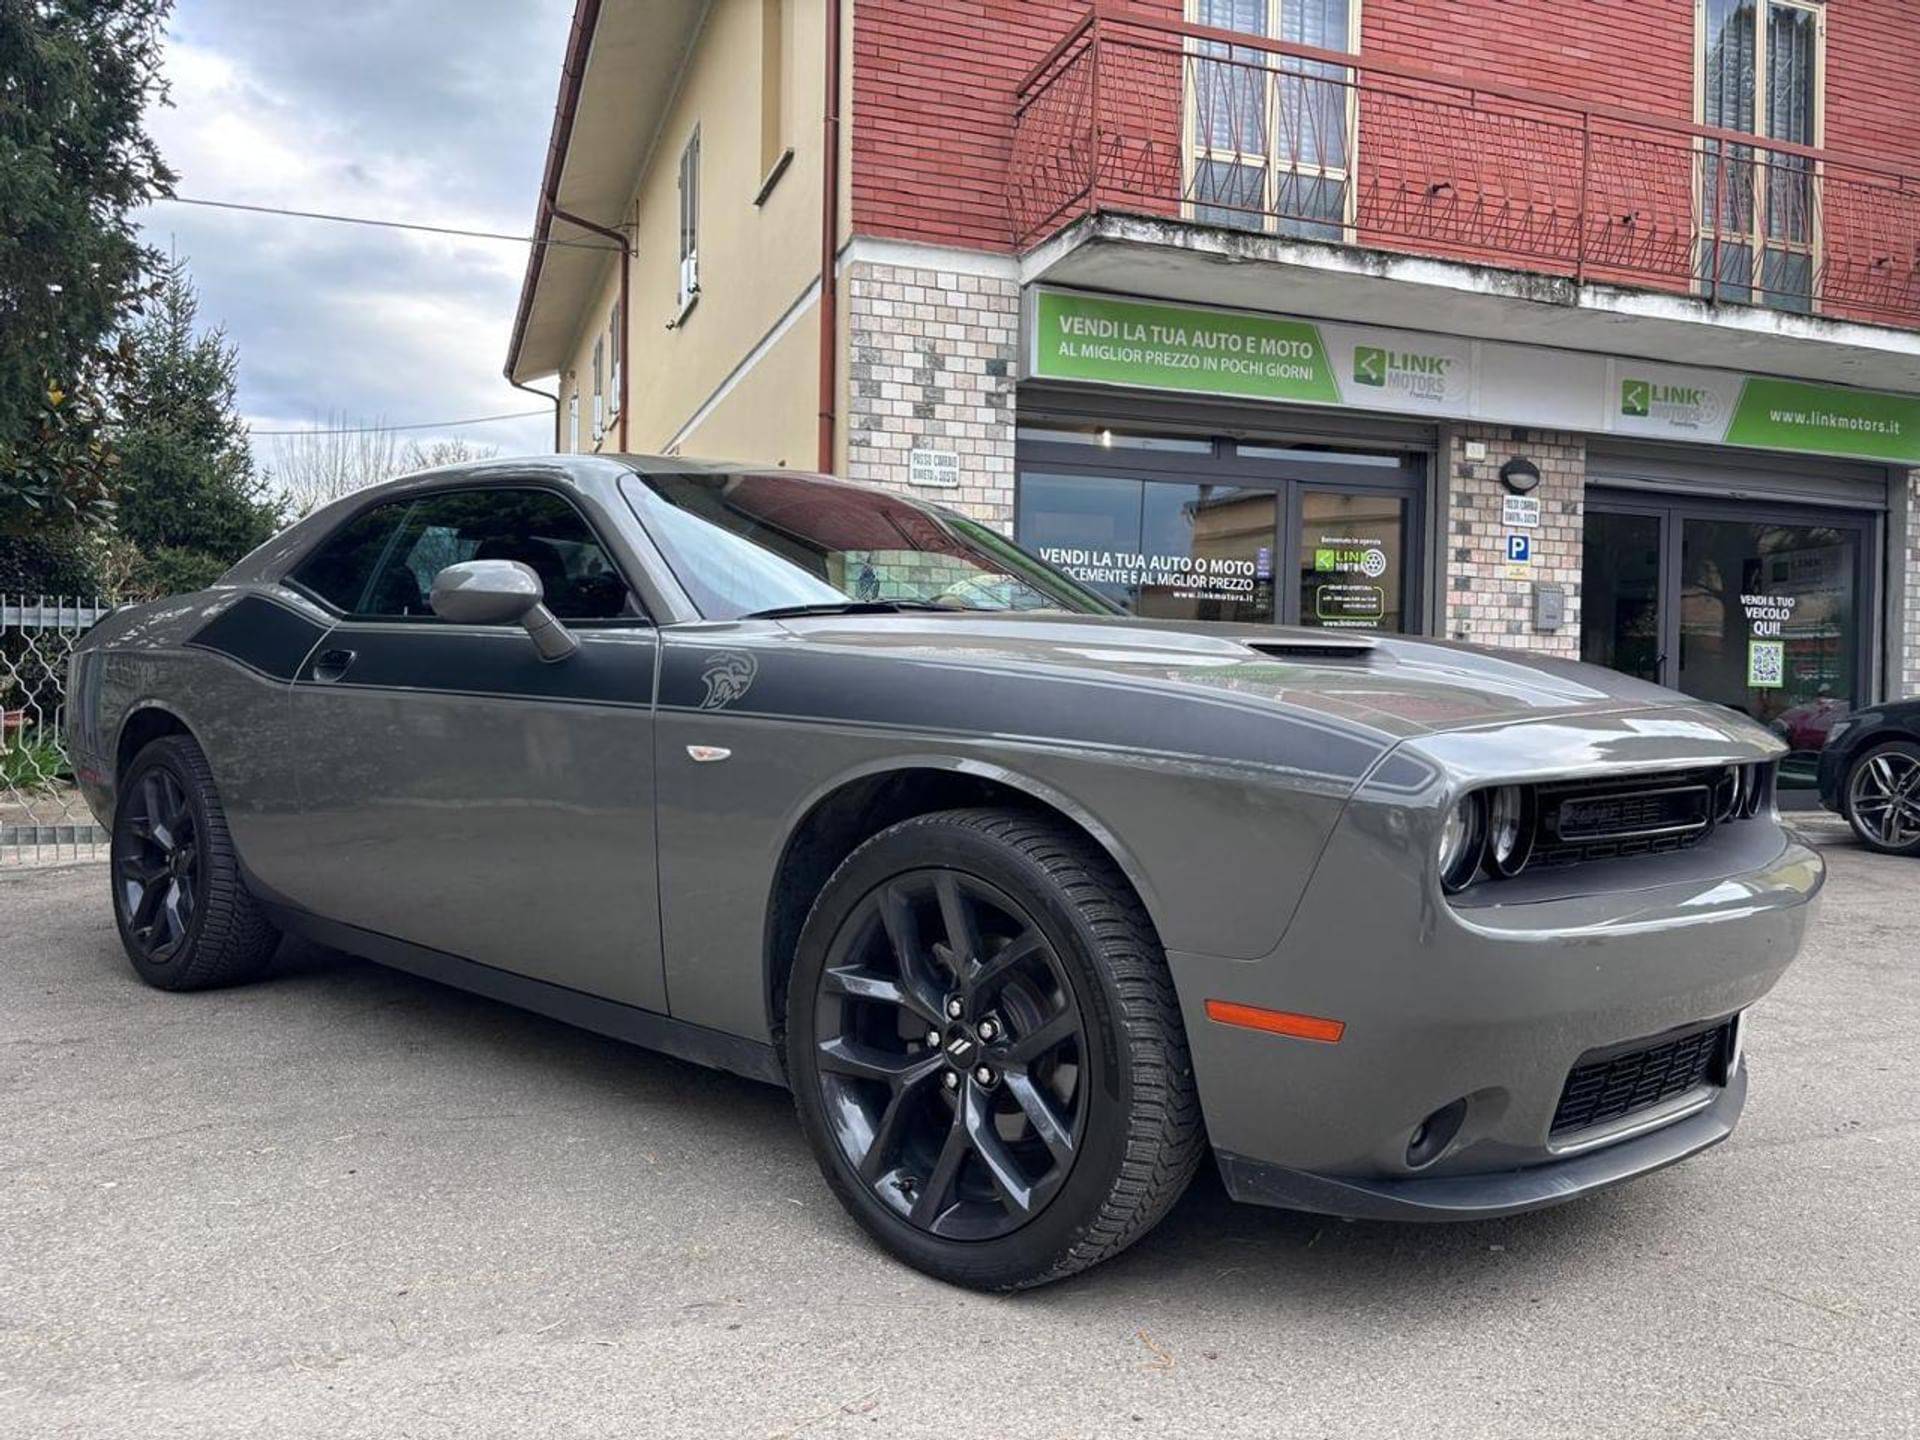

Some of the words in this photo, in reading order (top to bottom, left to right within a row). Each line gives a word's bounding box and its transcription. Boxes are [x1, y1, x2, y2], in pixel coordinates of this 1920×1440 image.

[1059, 315, 1119, 339] VENDI
[1123, 322, 1147, 342] LA
[1150, 325, 1188, 346] TUA
[1191, 330, 1242, 352] AUTO
[1246, 336, 1257, 354] E
[1260, 338, 1313, 359] MOTO
[1058, 341, 1078, 357] AL
[1080, 344, 1142, 363] MIGLIOR
[1144, 350, 1201, 369] PREZZO
[1203, 357, 1218, 371] IN
[1220, 358, 1263, 376] POCHI
[1265, 362, 1314, 381] GIORNI
[1388, 371, 1445, 393] MOTORS
[1769, 409, 1900, 435] www.linkmotors.it
[1511, 538, 1524, 557] P
[1040, 547, 1089, 565] VENDI
[1092, 551, 1113, 567] LA
[1115, 552, 1147, 569] TUA
[1149, 555, 1192, 572] AUTO
[1195, 558, 1207, 573] O
[1209, 559, 1255, 576] MOTO
[1130, 570, 1138, 584] E
[1140, 571, 1156, 585] AL
[1157, 572, 1207, 588] MIGLIOR
[1208, 577, 1255, 591] PREZZO
[1173, 590, 1254, 602] www.linkmotors.it
[1740, 594, 1767, 606] VENDI
[1768, 596, 1776, 606] IL
[1776, 596, 1795, 608] TUO
[1745, 606, 1790, 621] VEICOLO
[1753, 620, 1780, 636] QUI!
